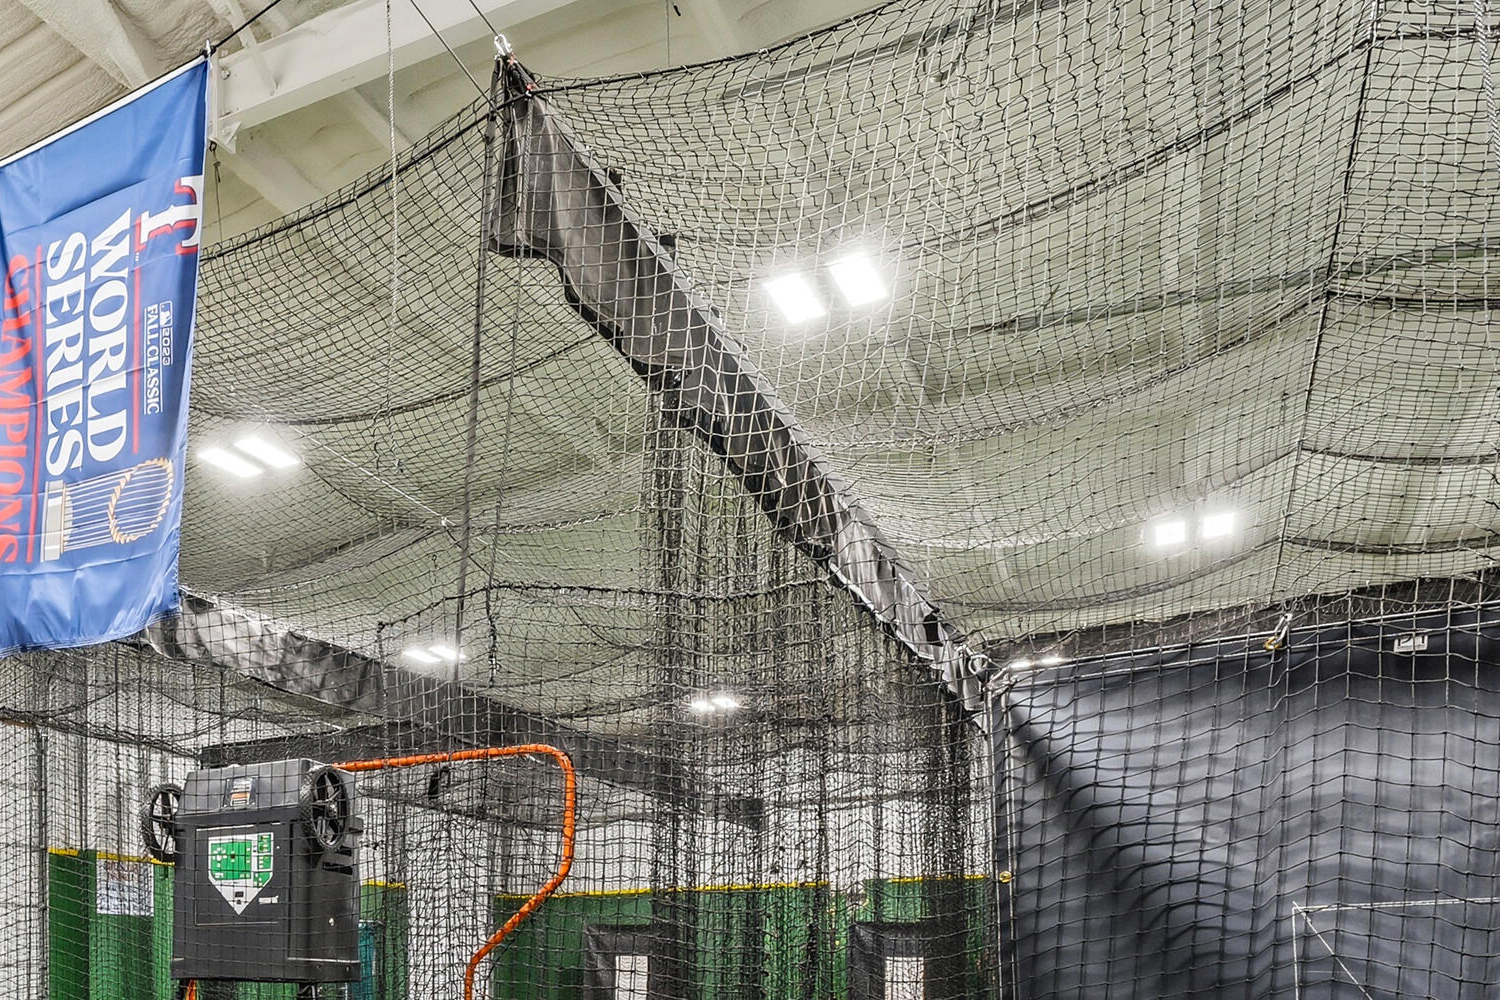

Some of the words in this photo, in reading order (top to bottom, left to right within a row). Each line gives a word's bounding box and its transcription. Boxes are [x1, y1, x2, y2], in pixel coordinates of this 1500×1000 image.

[45, 231, 88, 476] SERIES
[87, 207, 132, 463] WORLD
[147, 303, 159, 345] FALL
[162, 327, 171, 366] 2023
[147, 346, 160, 415] CLASSIC
